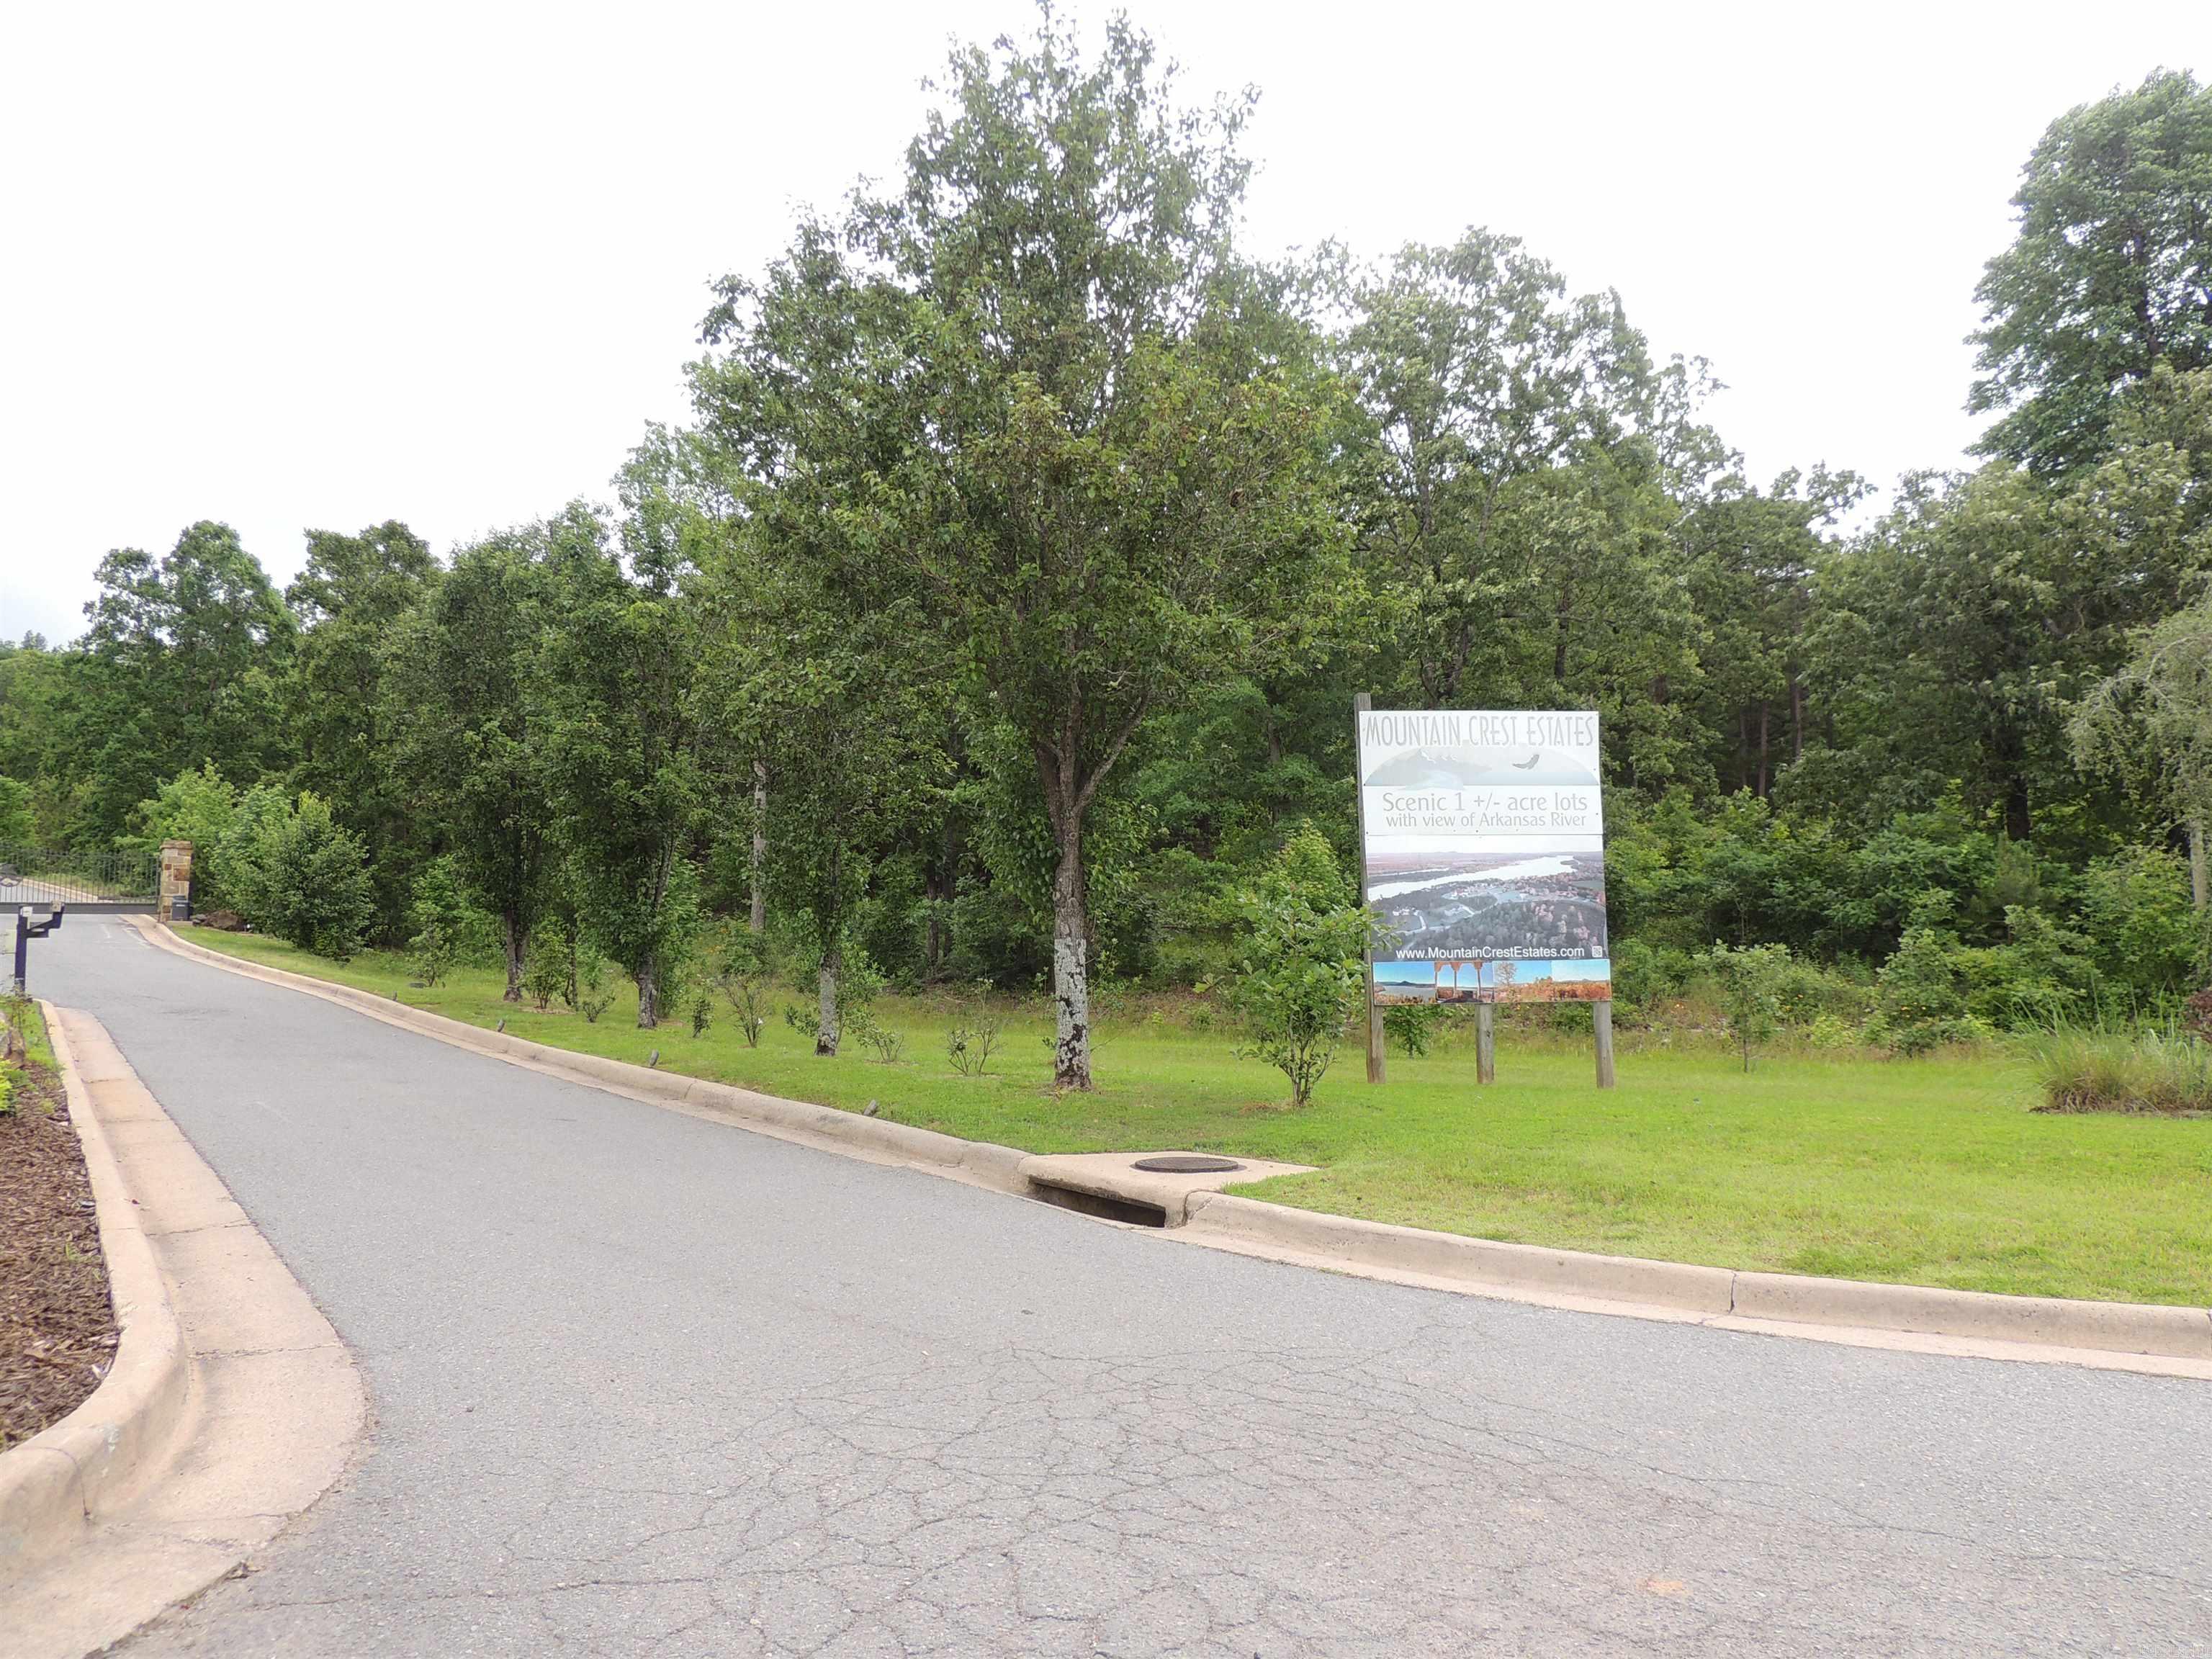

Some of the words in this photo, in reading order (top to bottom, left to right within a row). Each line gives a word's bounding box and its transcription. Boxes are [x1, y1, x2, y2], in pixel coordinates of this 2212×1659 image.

[1365, 716, 1461, 746] MOUNTAIN
[1469, 716, 1517, 746] CREST
[1527, 716, 1593, 746] ESTATES
[1382, 792, 1447, 811] Scenic
[1455, 793, 1465, 811] 1
[1508, 797, 1547, 811] acre
[1555, 793, 1588, 811] lots
[1386, 812, 1417, 827] with
[1423, 814, 1456, 827] view
[1461, 812, 1476, 827] of
[1480, 812, 1546, 827] Arkansas
[1552, 812, 1586, 827] River
[1395, 946, 1585, 959] www.MountainCrestEstates.com
